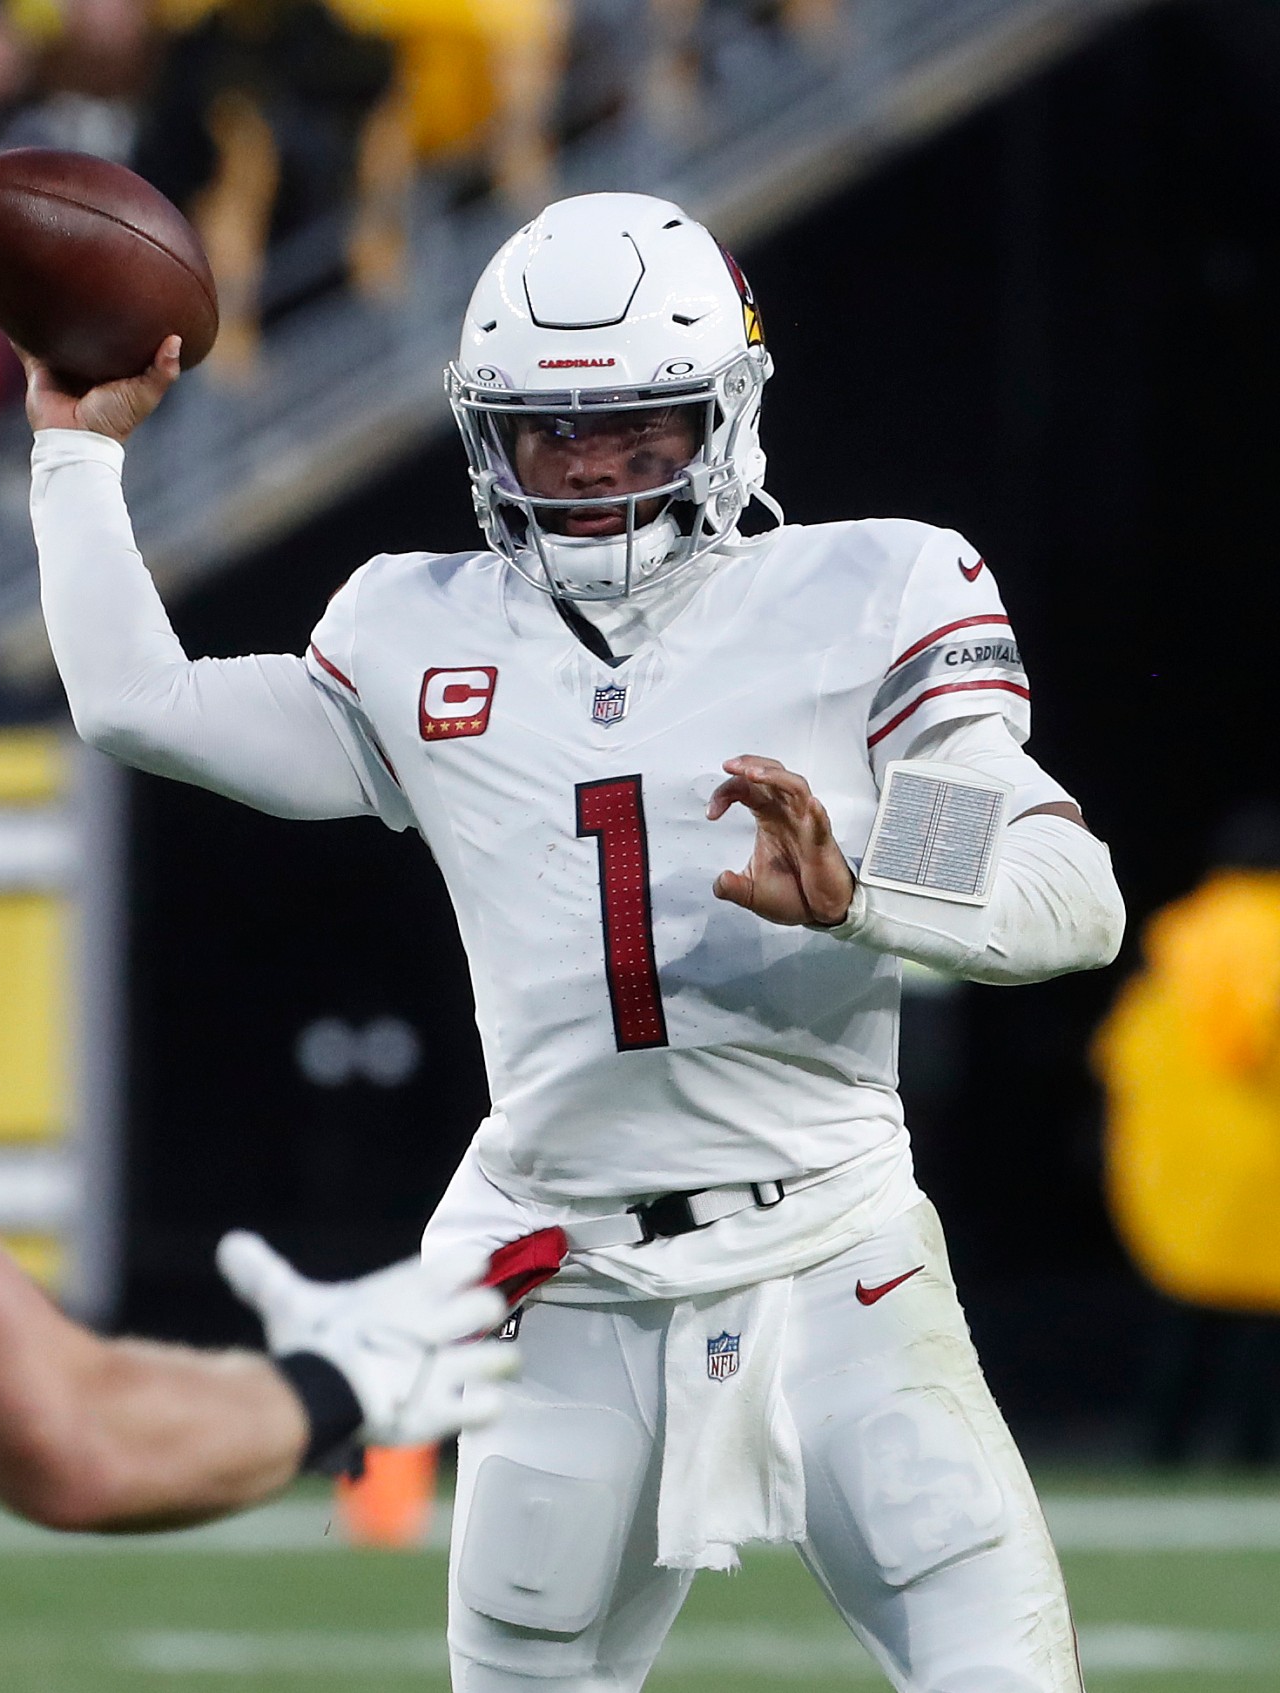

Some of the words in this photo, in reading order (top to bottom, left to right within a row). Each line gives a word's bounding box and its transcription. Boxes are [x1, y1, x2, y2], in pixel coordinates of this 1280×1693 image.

[538, 358, 616, 369] CARDINALS
[424, 670, 491, 719] C
[596, 701, 621, 718] NFL
[574, 773, 669, 1053] 1
[710, 1354, 736, 1377] NFL
